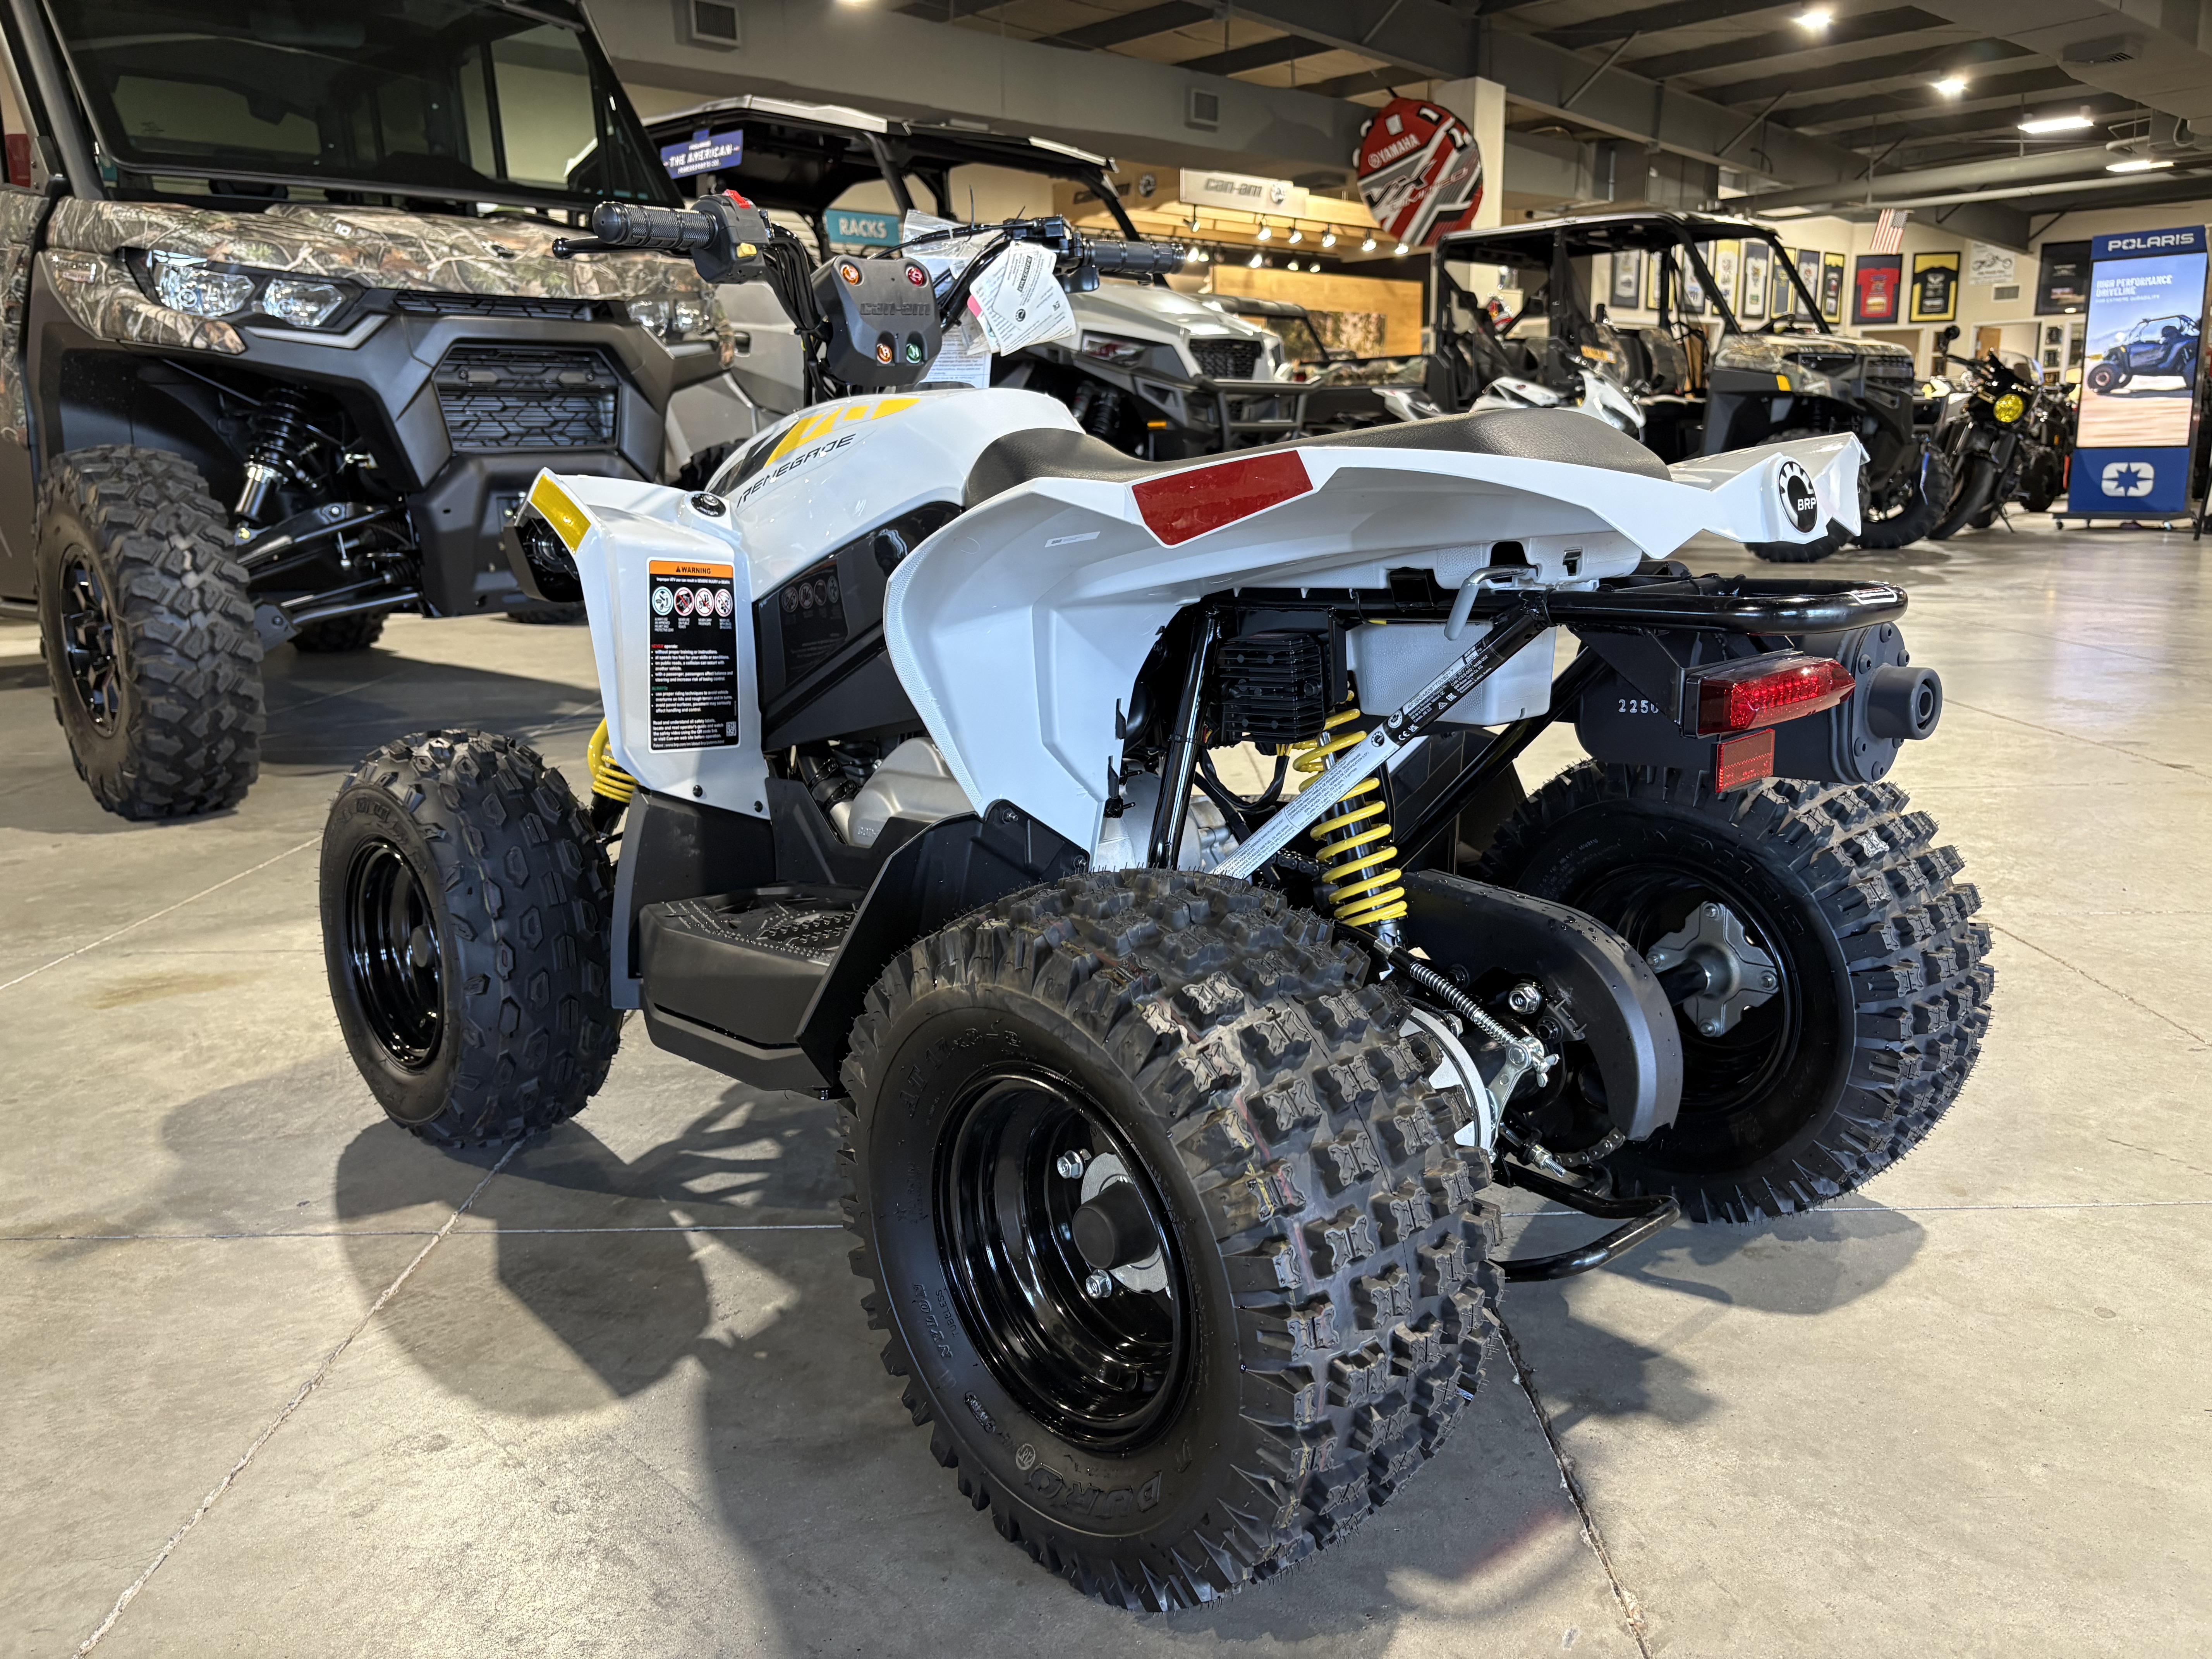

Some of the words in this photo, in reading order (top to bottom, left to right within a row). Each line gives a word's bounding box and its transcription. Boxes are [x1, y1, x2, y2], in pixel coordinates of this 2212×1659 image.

[1377, 133, 1421, 163] YAMAHA
[1205, 178, 1262, 197] can-am
[839, 217, 887, 239] RACKS
[2108, 233, 2194, 251] POLARIS
[2116, 275, 2172, 287] PERFORMANCE
[860, 303, 930, 315] can-am
[1798, 497, 1816, 511] BRP
[912, 1283, 953, 1360] NYLON
[936, 1290, 959, 1337] TUBELESS
[1029, 1462, 1162, 1518] DURO
